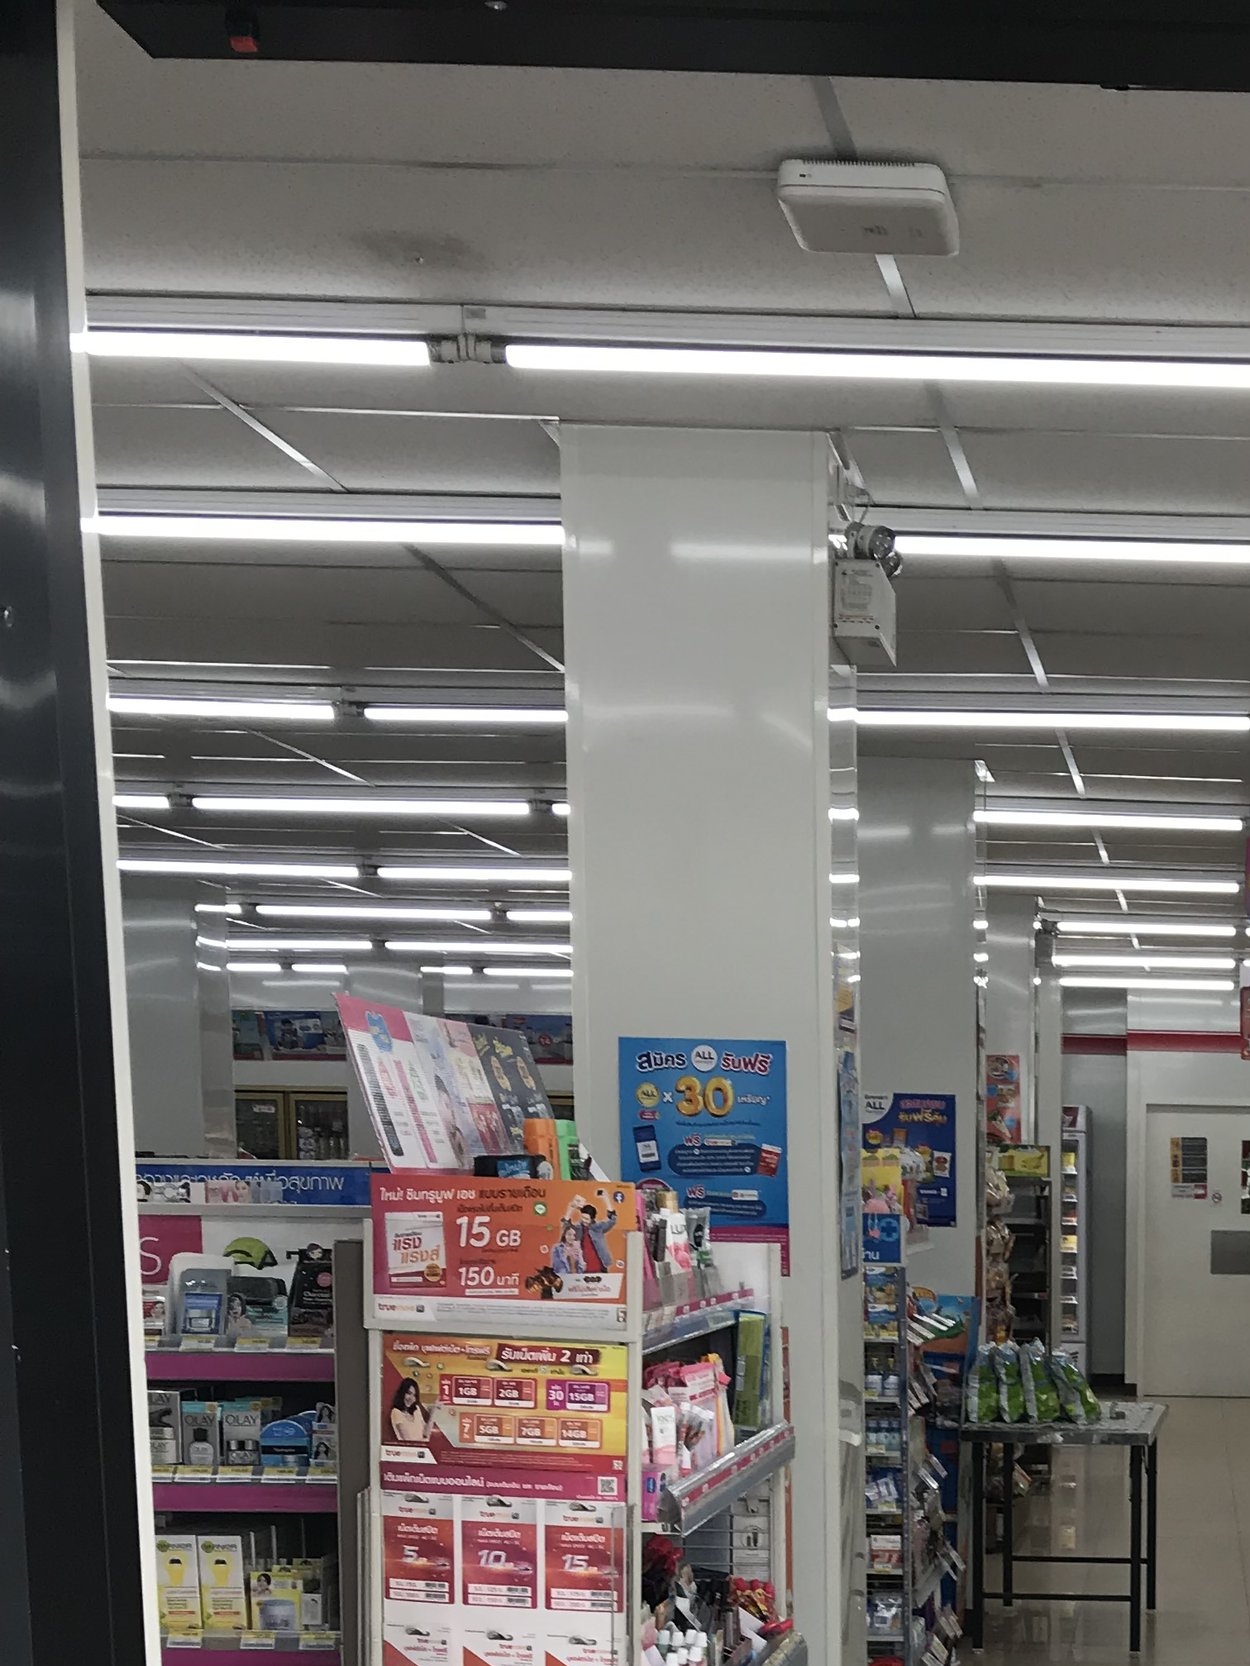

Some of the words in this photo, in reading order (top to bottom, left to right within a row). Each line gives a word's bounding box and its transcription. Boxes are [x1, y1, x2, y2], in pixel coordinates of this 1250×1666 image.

[695, 1051, 714, 1060] ALL
[636, 1051, 687, 1072] สมัคร
[721, 1052, 772, 1075] รับฟรี
[676, 1076, 734, 1118] 30
[865, 1101, 885, 1110] ALL
[456, 1216, 492, 1248] 15
[496, 1229, 521, 1247] GB
[459, 1266, 493, 1286] 150
[496, 1273, 519, 1286] นาที
[561, 1350, 571, 1362] 2
[458, 1387, 477, 1397] 1GB
[499, 1389, 519, 1399] 2GB
[549, 1390, 564, 1400] 30
[568, 1391, 594, 1402] 15GB
[149, 1394, 172, 1405] LAY
[184, 1415, 215, 1426] OLAY
[225, 1414, 257, 1425] OLAY
[480, 1425, 498, 1435] 5GB
[402, 1545, 419, 1562] 5
[477, 1549, 506, 1568] 10
[562, 1554, 590, 1571] 15
